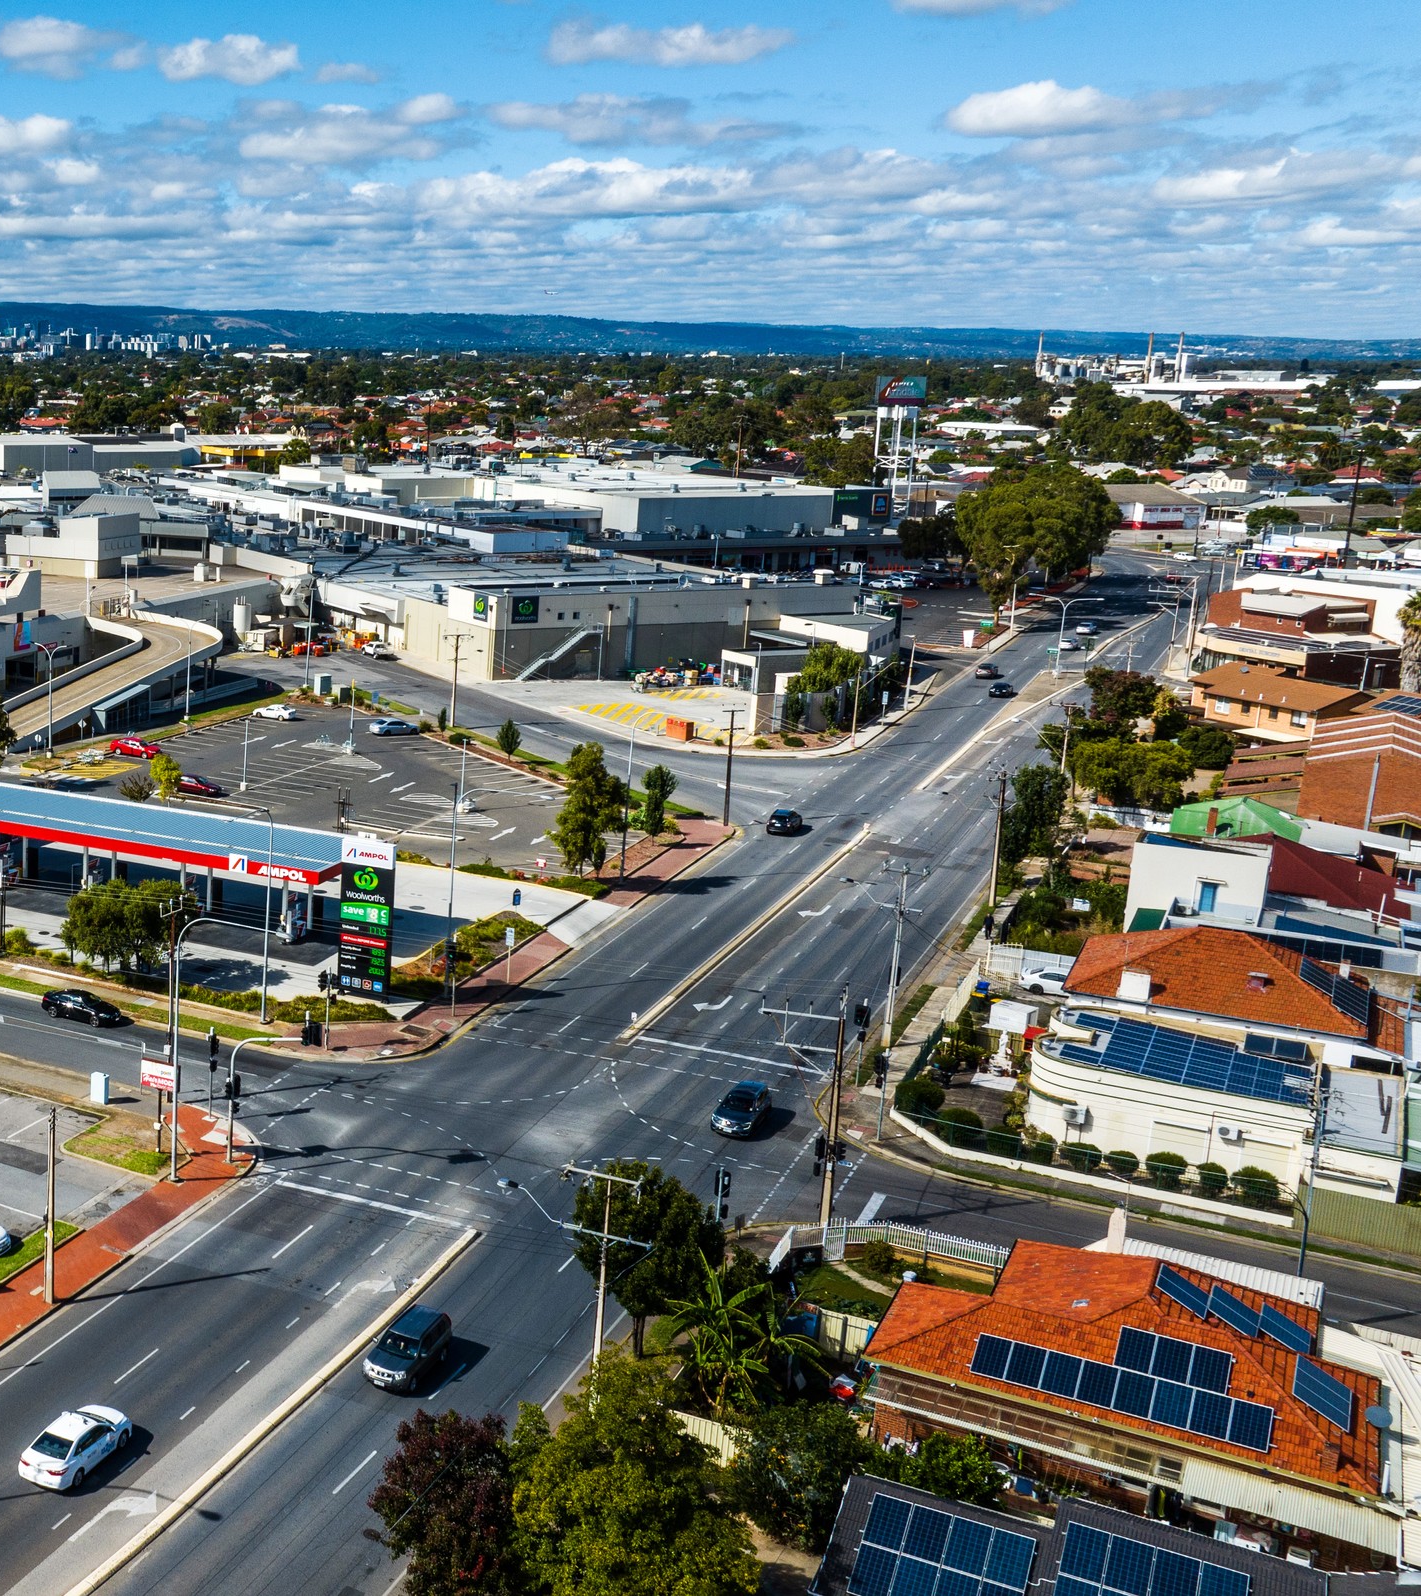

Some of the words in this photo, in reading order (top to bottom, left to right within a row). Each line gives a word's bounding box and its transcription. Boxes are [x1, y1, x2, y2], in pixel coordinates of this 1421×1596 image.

[358, 851, 389, 861] AMPOL
[257, 865, 307, 882] AMPOL
[345, 890, 386, 904] Woolworths
[343, 905, 365, 916] save
